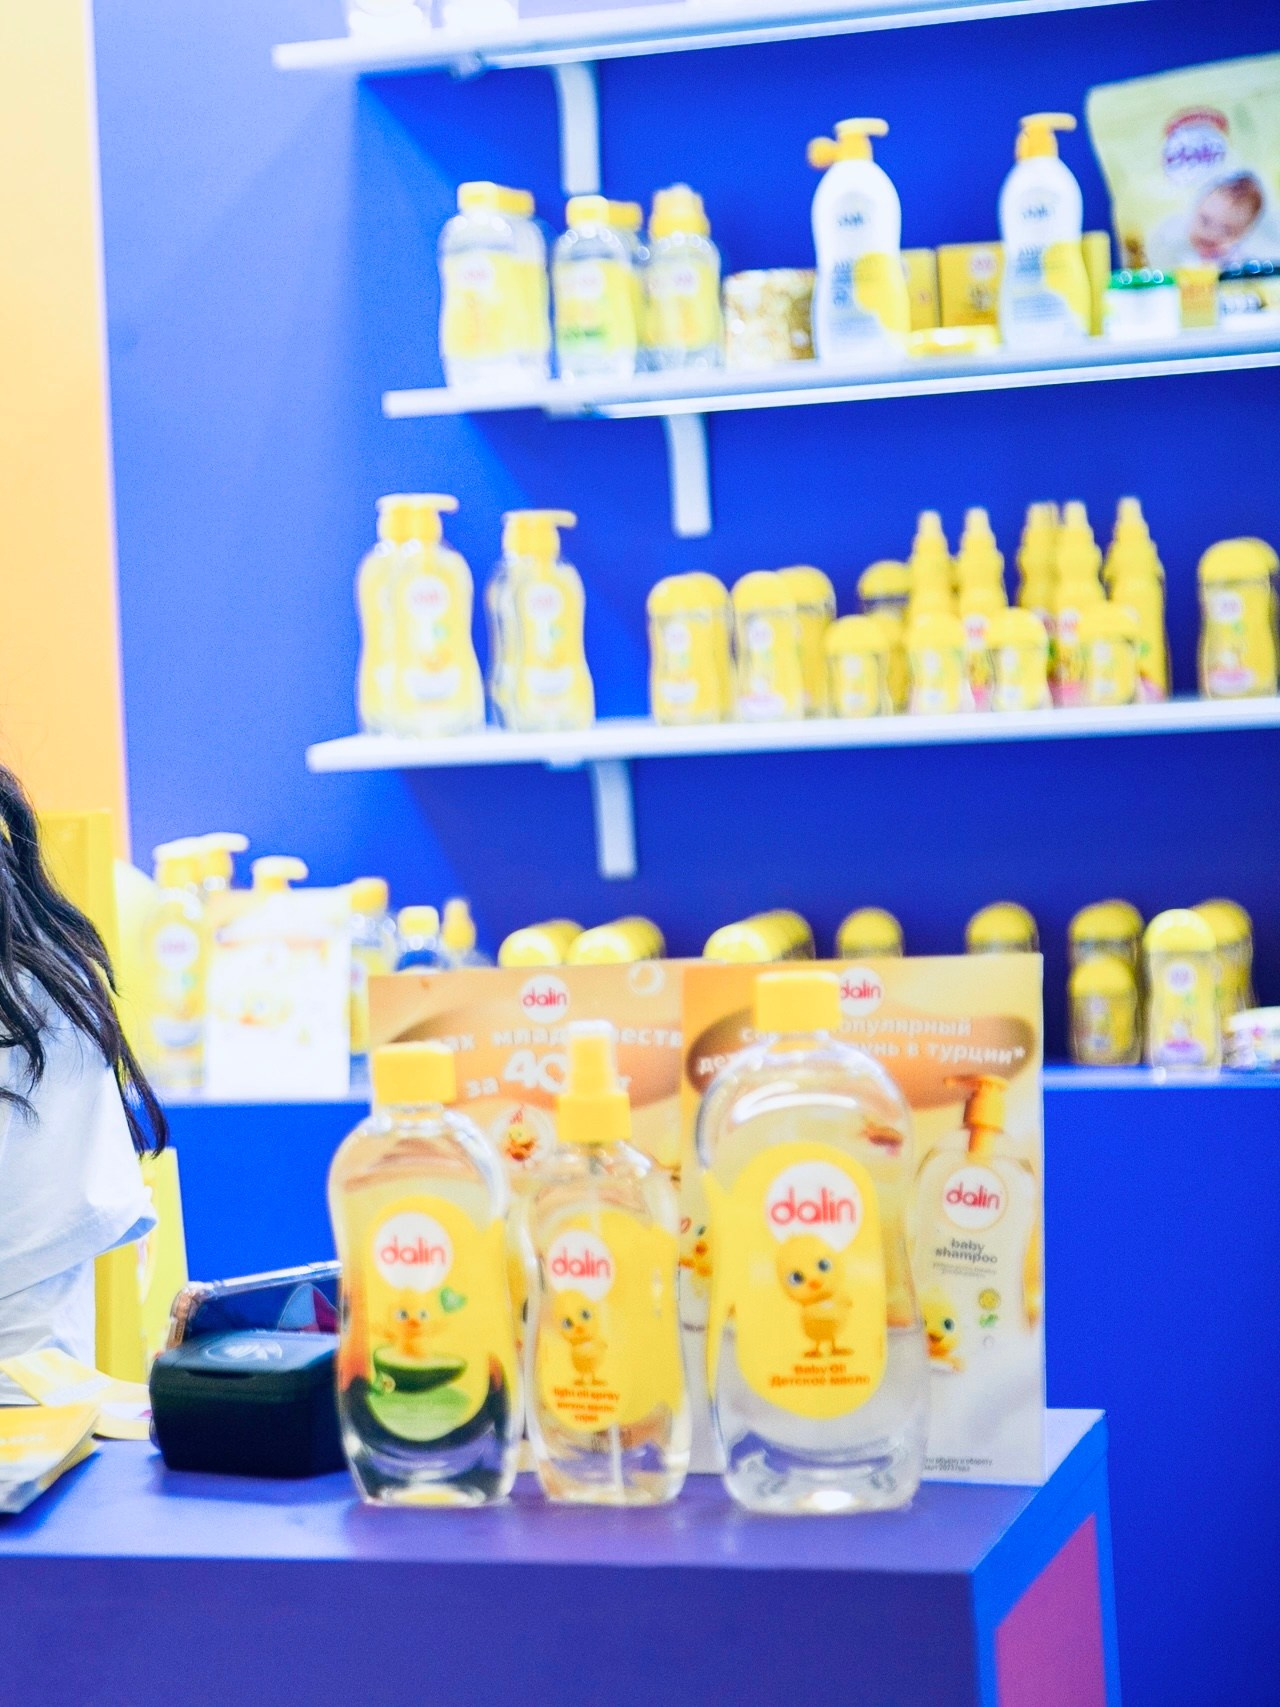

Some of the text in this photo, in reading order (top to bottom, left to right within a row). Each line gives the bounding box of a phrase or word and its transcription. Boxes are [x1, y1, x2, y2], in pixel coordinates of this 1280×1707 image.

[523, 987, 567, 1008] dalin
[840, 1018, 972, 1037] опулярный
[770, 1187, 857, 1226] dalin
[946, 1182, 1000, 1210] dalin
[380, 1235, 446, 1267] dalin
[935, 1247, 998, 1264] shampoo
[951, 1238, 985, 1252] baby
[551, 1249, 611, 1280] dalin
